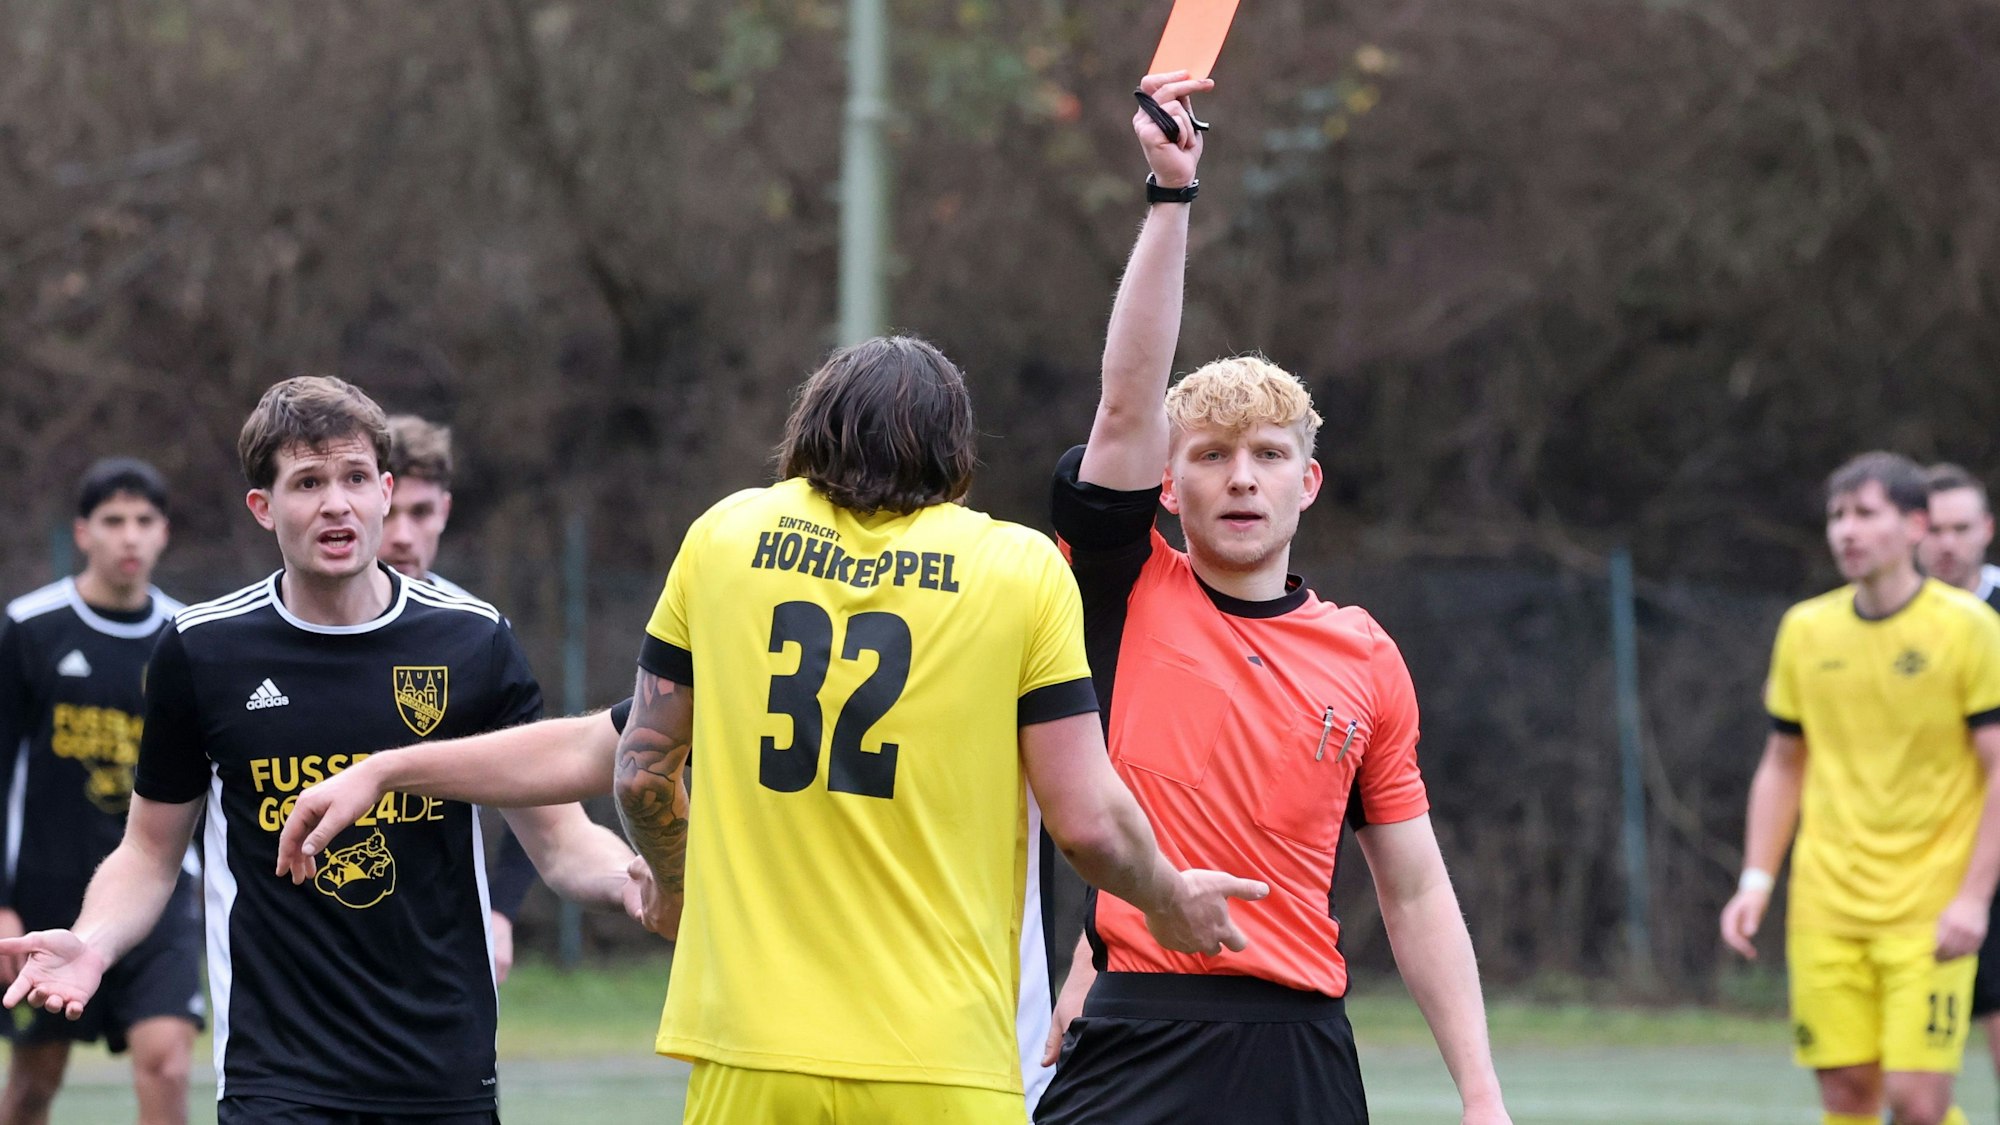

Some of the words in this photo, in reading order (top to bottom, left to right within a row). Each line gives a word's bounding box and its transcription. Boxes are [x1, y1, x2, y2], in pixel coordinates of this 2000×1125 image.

[778, 516, 841, 542] EINTRACHT
[751, 531, 959, 593] HOHKEPPEL
[246, 696, 290, 711] adidas
[759, 600, 912, 799] 32
